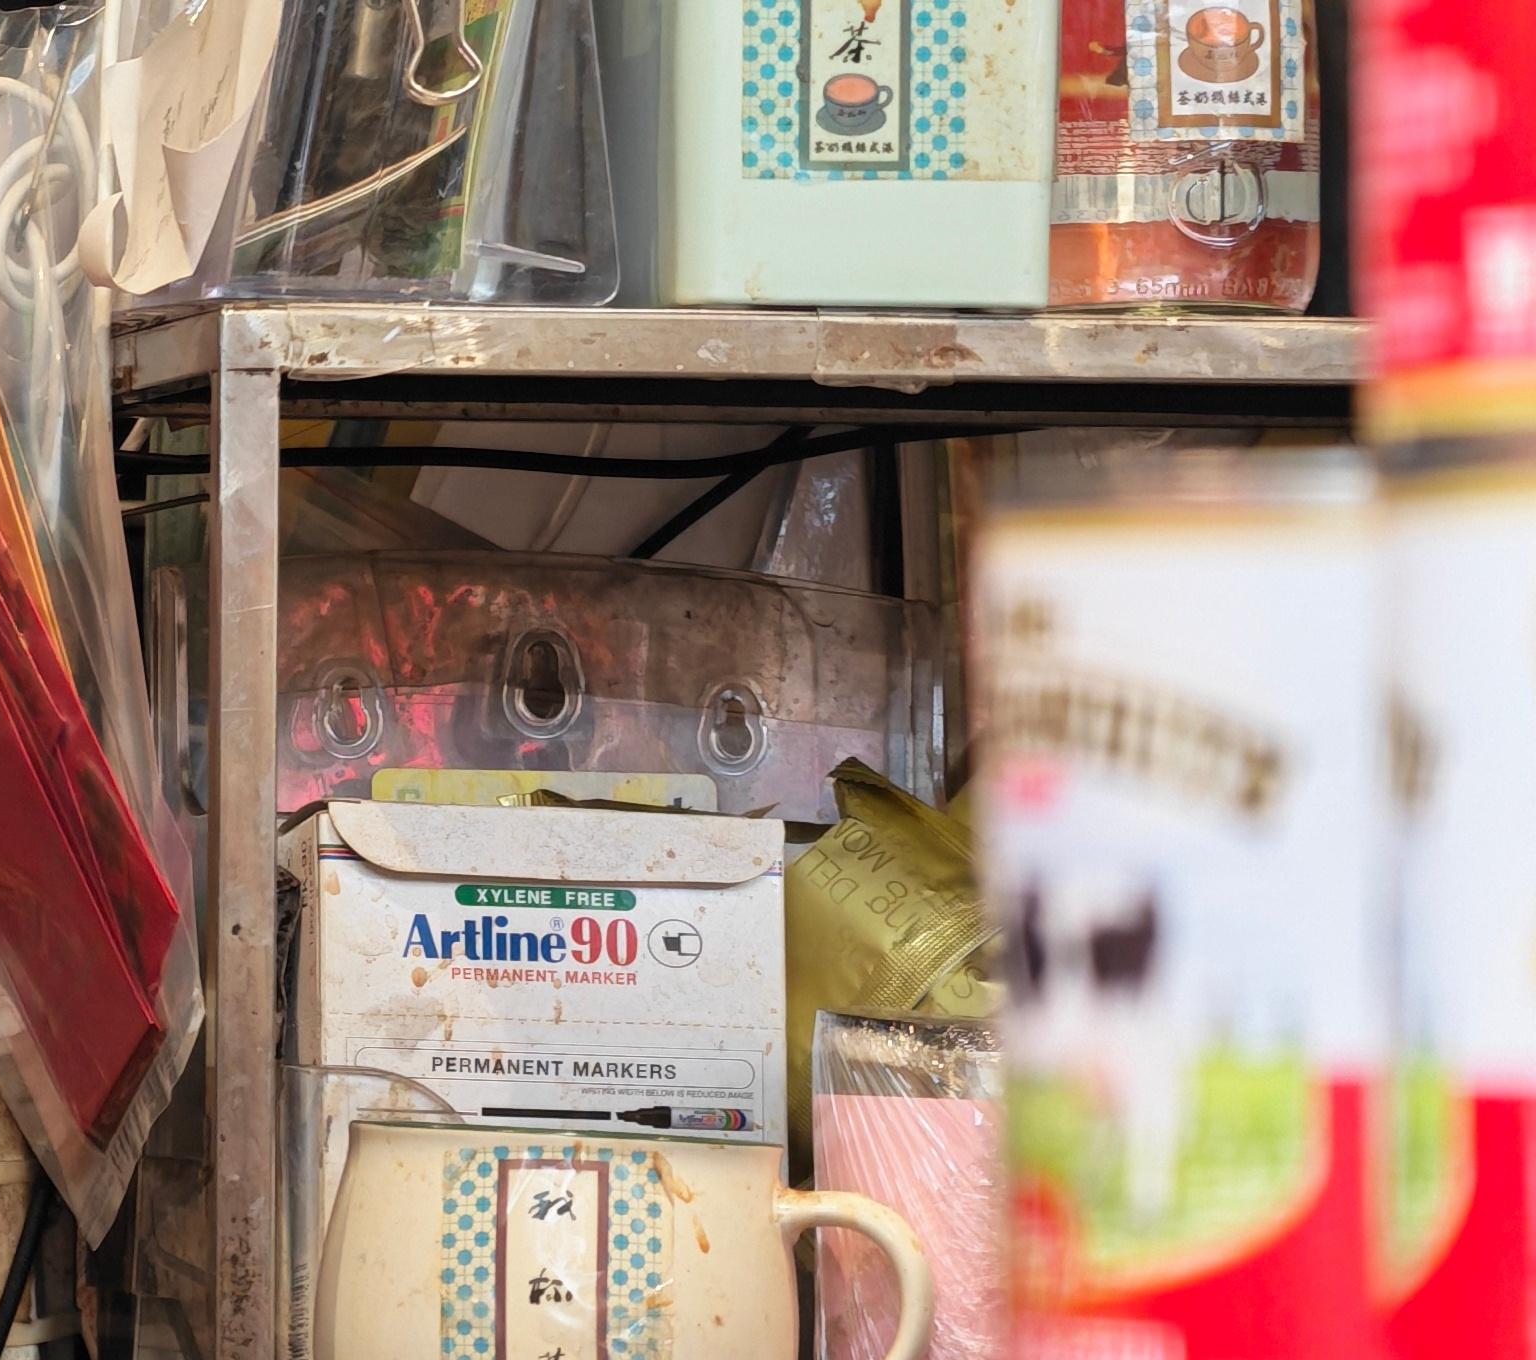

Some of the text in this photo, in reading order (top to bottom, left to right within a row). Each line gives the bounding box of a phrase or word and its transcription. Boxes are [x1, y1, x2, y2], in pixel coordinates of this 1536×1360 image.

[476, 887, 616, 908] XYLENE FREE
[402, 913, 639, 966] Artline 90
[450, 967, 637, 986] PERMANENT MARKER
[431, 1056, 677, 1080] PERMANENT MARKERS
[645, 1089, 675, 1097] BELOW
[686, 1091, 726, 1099] REDUCED
[727, 1092, 754, 1100] IMAGE
